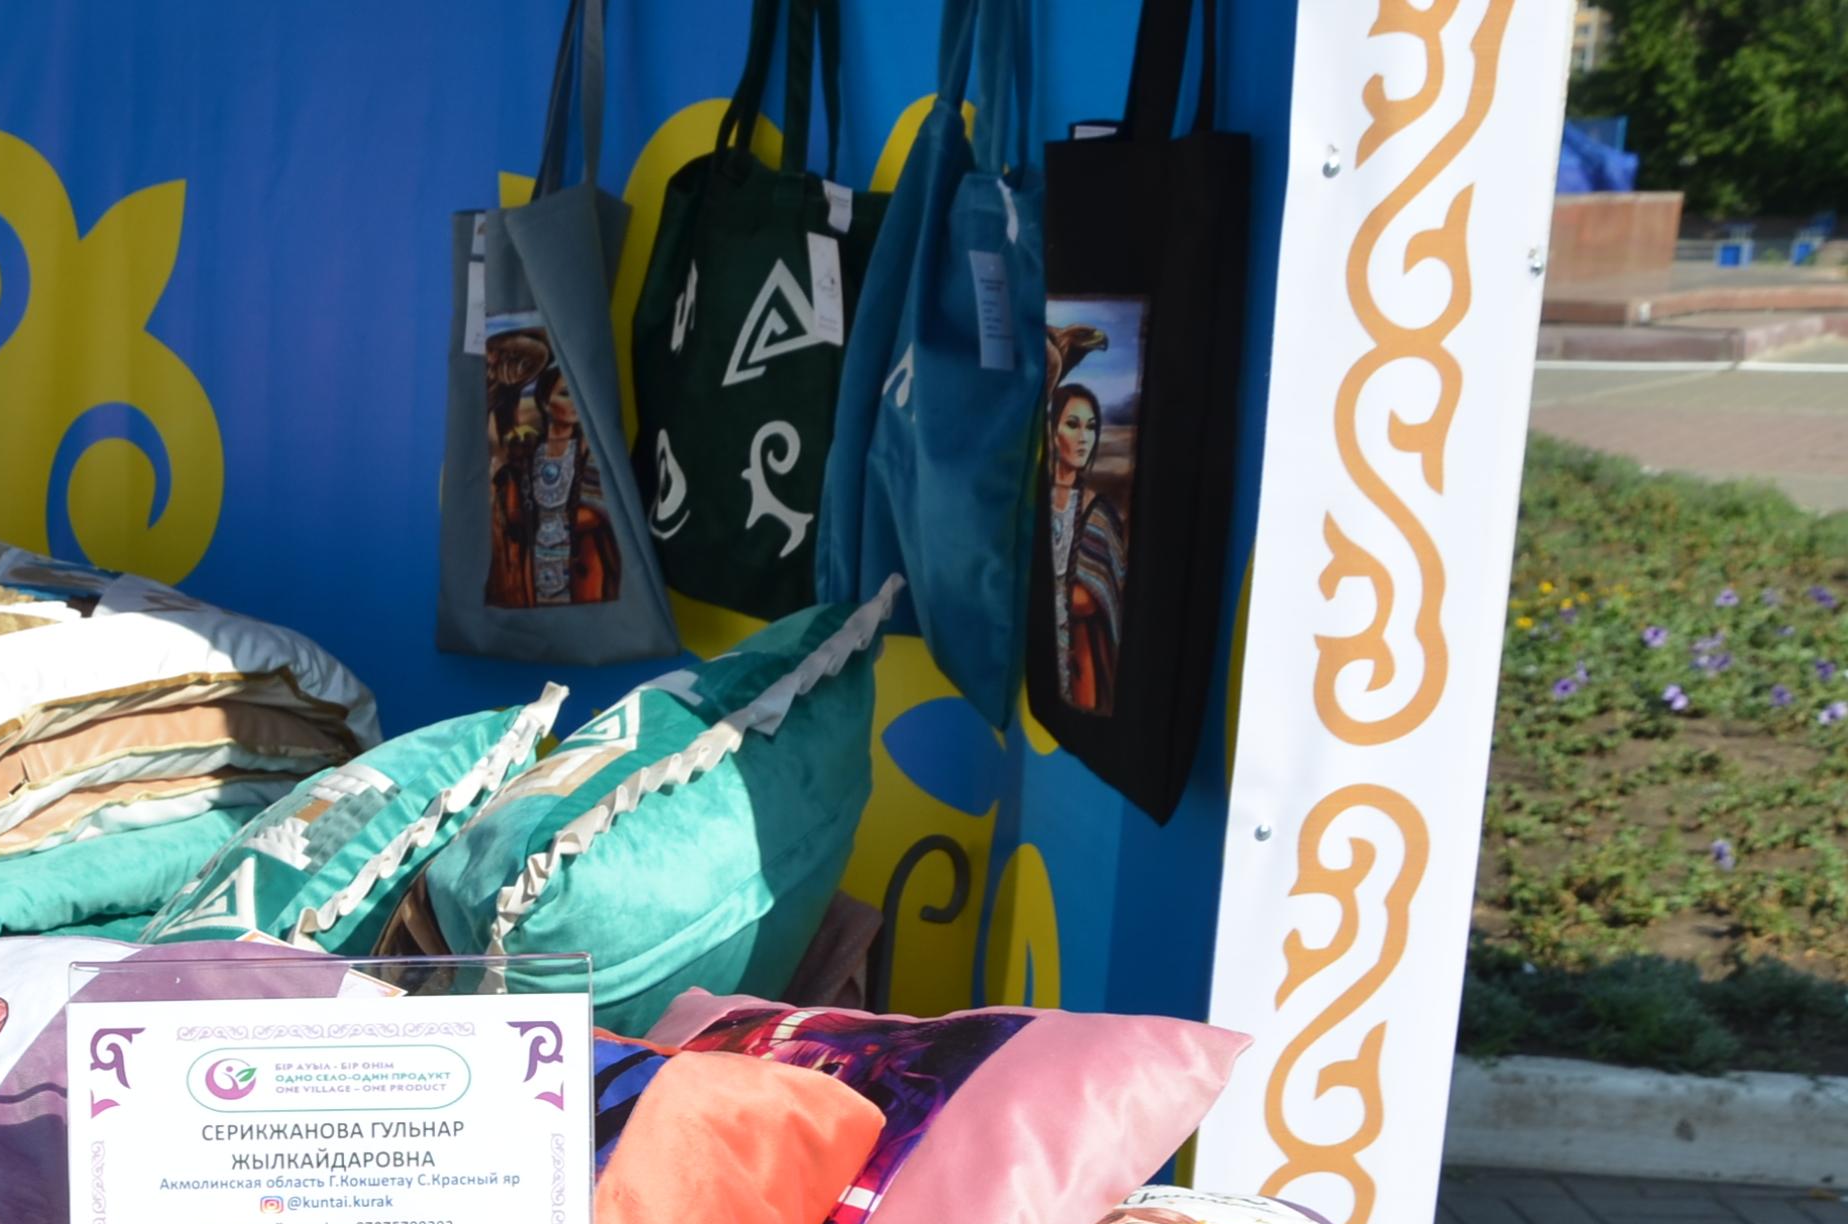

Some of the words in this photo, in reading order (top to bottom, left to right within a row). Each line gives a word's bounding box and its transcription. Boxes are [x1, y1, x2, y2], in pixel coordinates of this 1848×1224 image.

[274, 1062, 294, 1072] БІР
[295, 1062, 332, 1071] АУЫЛ
[340, 1061, 360, 1071] БІР
[274, 1074, 312, 1086] ОДНО
[391, 1071, 451, 1083] ПРОДУКТ
[275, 1086, 299, 1094] ONE
[302, 1084, 350, 1094] VILLAGE
[362, 1083, 386, 1093] ONE
[390, 1082, 447, 1093] PRODUCT
[201, 1122, 365, 1142] СЕРИКЖАНОВА
[371, 1120, 465, 1139] ГУЛЬНАР
[231, 1148, 436, 1173] ЖЫЛКАЙДАРОВНА
[159, 1177, 262, 1191] Акмолинская
[265, 1175, 326, 1189] область
[328, 1174, 414, 1190] Г.Кокшетау
[416, 1171, 499, 1189] С.Красный
[502, 1174, 521, 1188] яр
[286, 1194, 394, 1212] @kuntai.kurak
